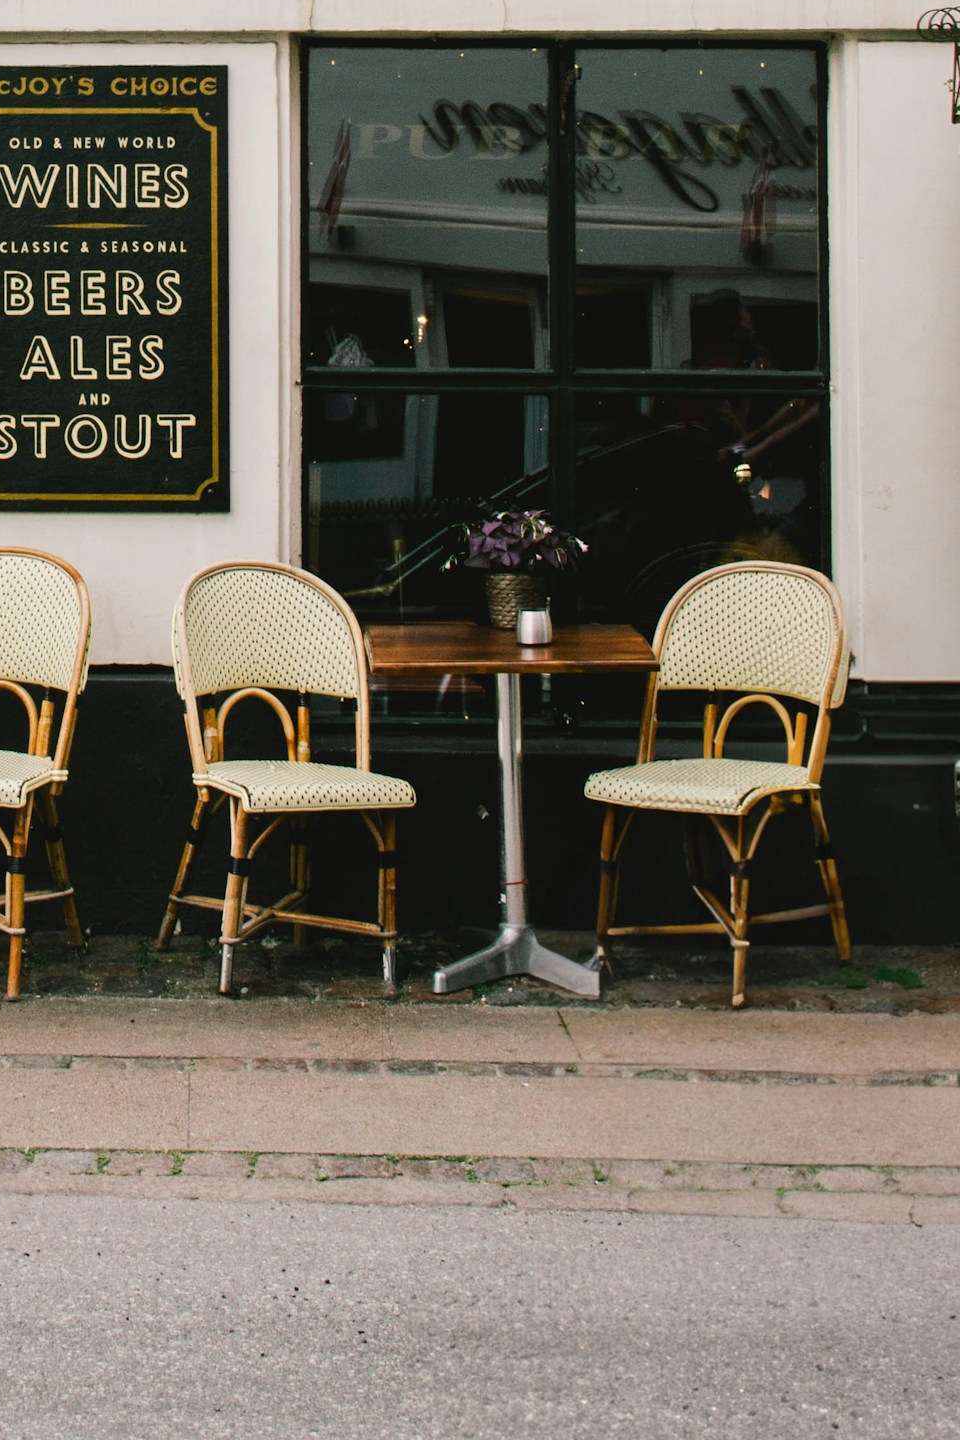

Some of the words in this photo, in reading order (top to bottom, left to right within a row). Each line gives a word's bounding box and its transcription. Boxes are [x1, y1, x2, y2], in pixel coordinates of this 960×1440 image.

[111, 78, 216, 95] CHOICE
[9, 137, 42, 149] OLD
[54, 138, 62, 149] &
[74, 137, 105, 148] NEW
[118, 137, 175, 148] WORLD
[353, 123, 526, 159] PUB
[0, 241, 68, 253] CLASSIC
[81, 242, 89, 252] &
[101, 241, 186, 253] SEASONAL
[4, 270, 182, 315] BEERS
[20, 335, 164, 380] ALES
[79, 394, 110, 405] AND
